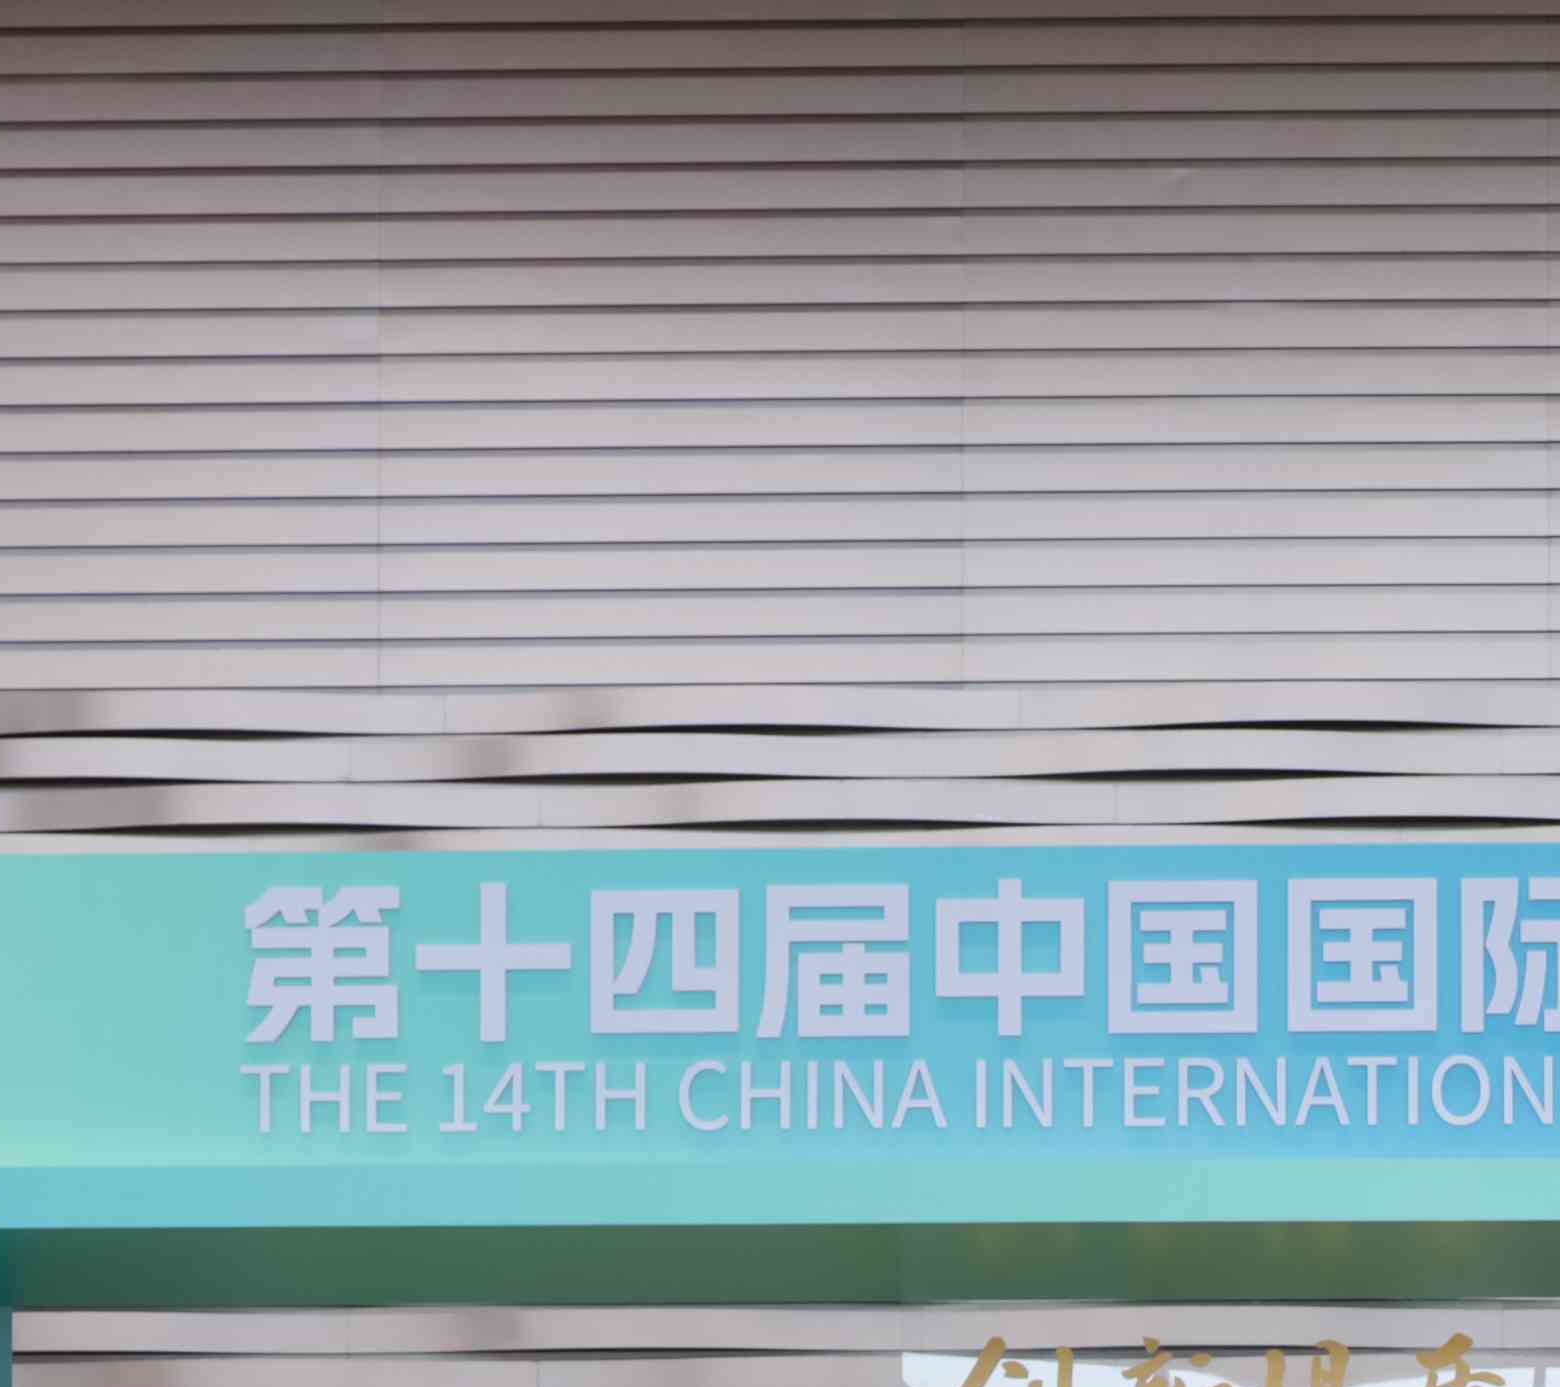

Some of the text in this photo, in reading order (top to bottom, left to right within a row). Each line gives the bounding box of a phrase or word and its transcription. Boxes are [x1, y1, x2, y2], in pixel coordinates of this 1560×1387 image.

[241, 1062, 406, 1134] THE
[438, 1061, 649, 1133] 14TH
[678, 1058, 947, 1132] CHINA
